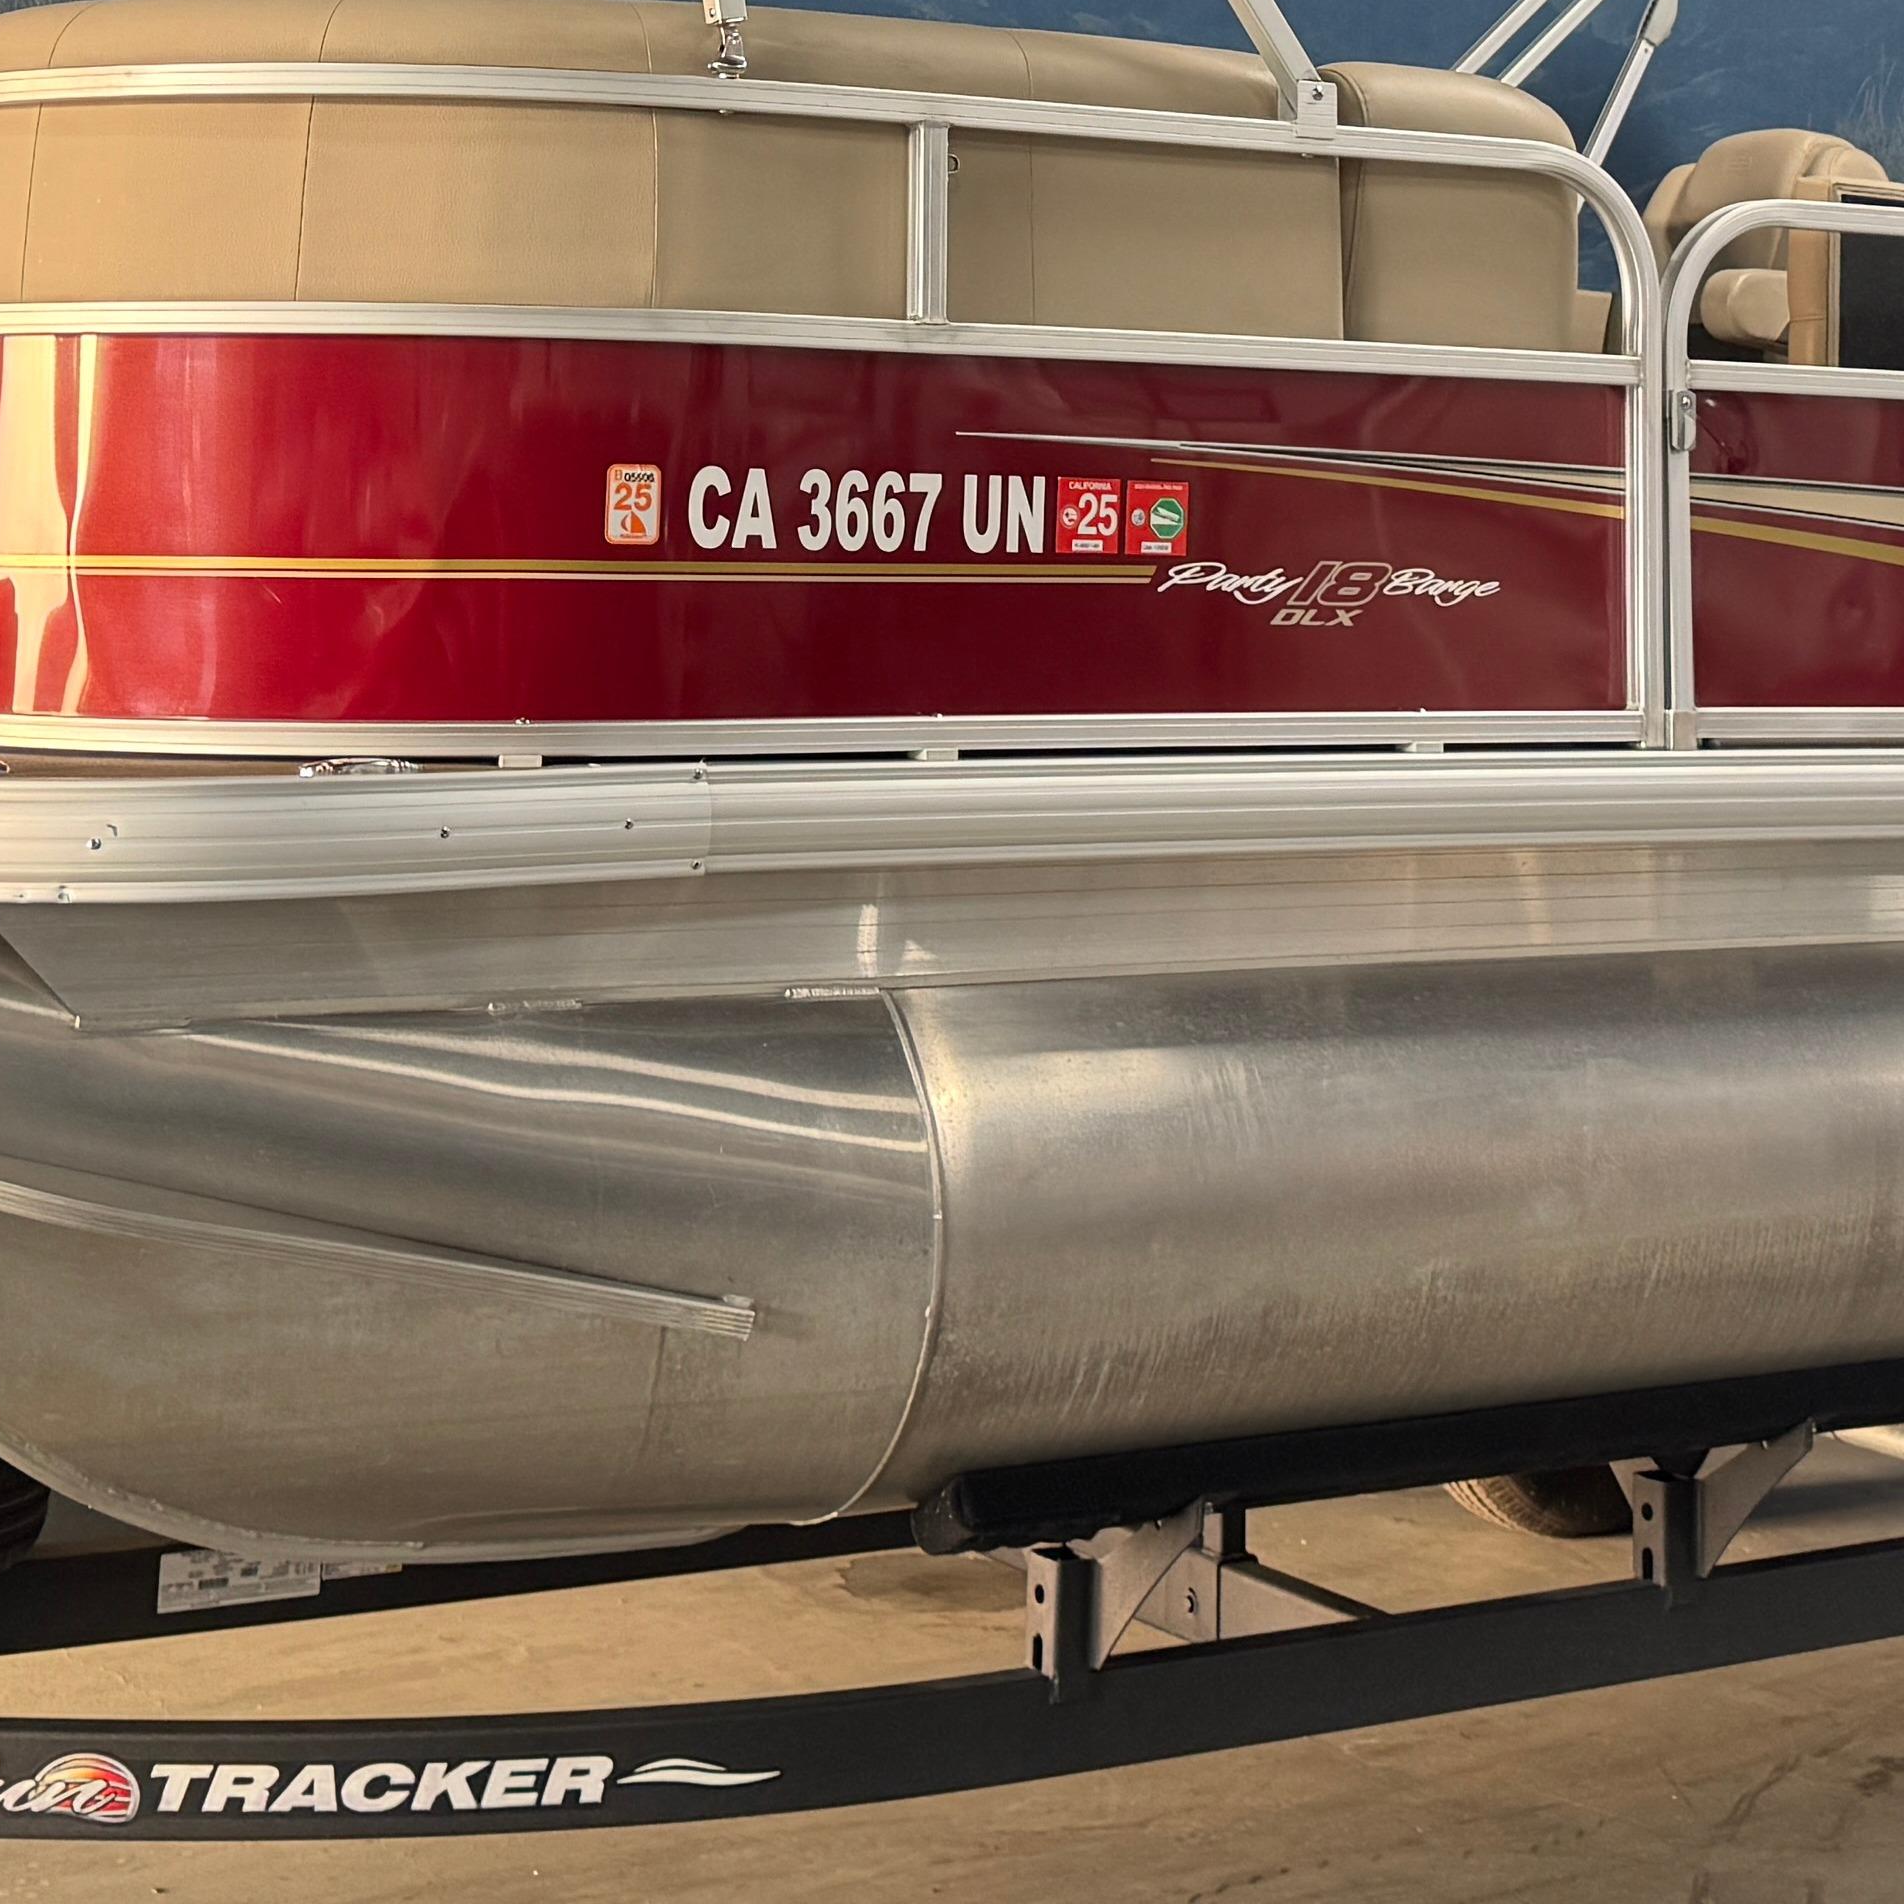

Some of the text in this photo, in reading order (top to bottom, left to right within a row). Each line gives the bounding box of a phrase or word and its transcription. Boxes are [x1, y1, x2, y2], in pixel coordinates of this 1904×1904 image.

[613, 482, 653, 512] 25
[688, 465, 1046, 554] CA 3667 UN
[1077, 492, 1119, 537] 25
[1156, 560, 1501, 607] Party 18 Barge
[1269, 608, 1363, 627] DLX
[151, 1756, 615, 1814] TRACKER
